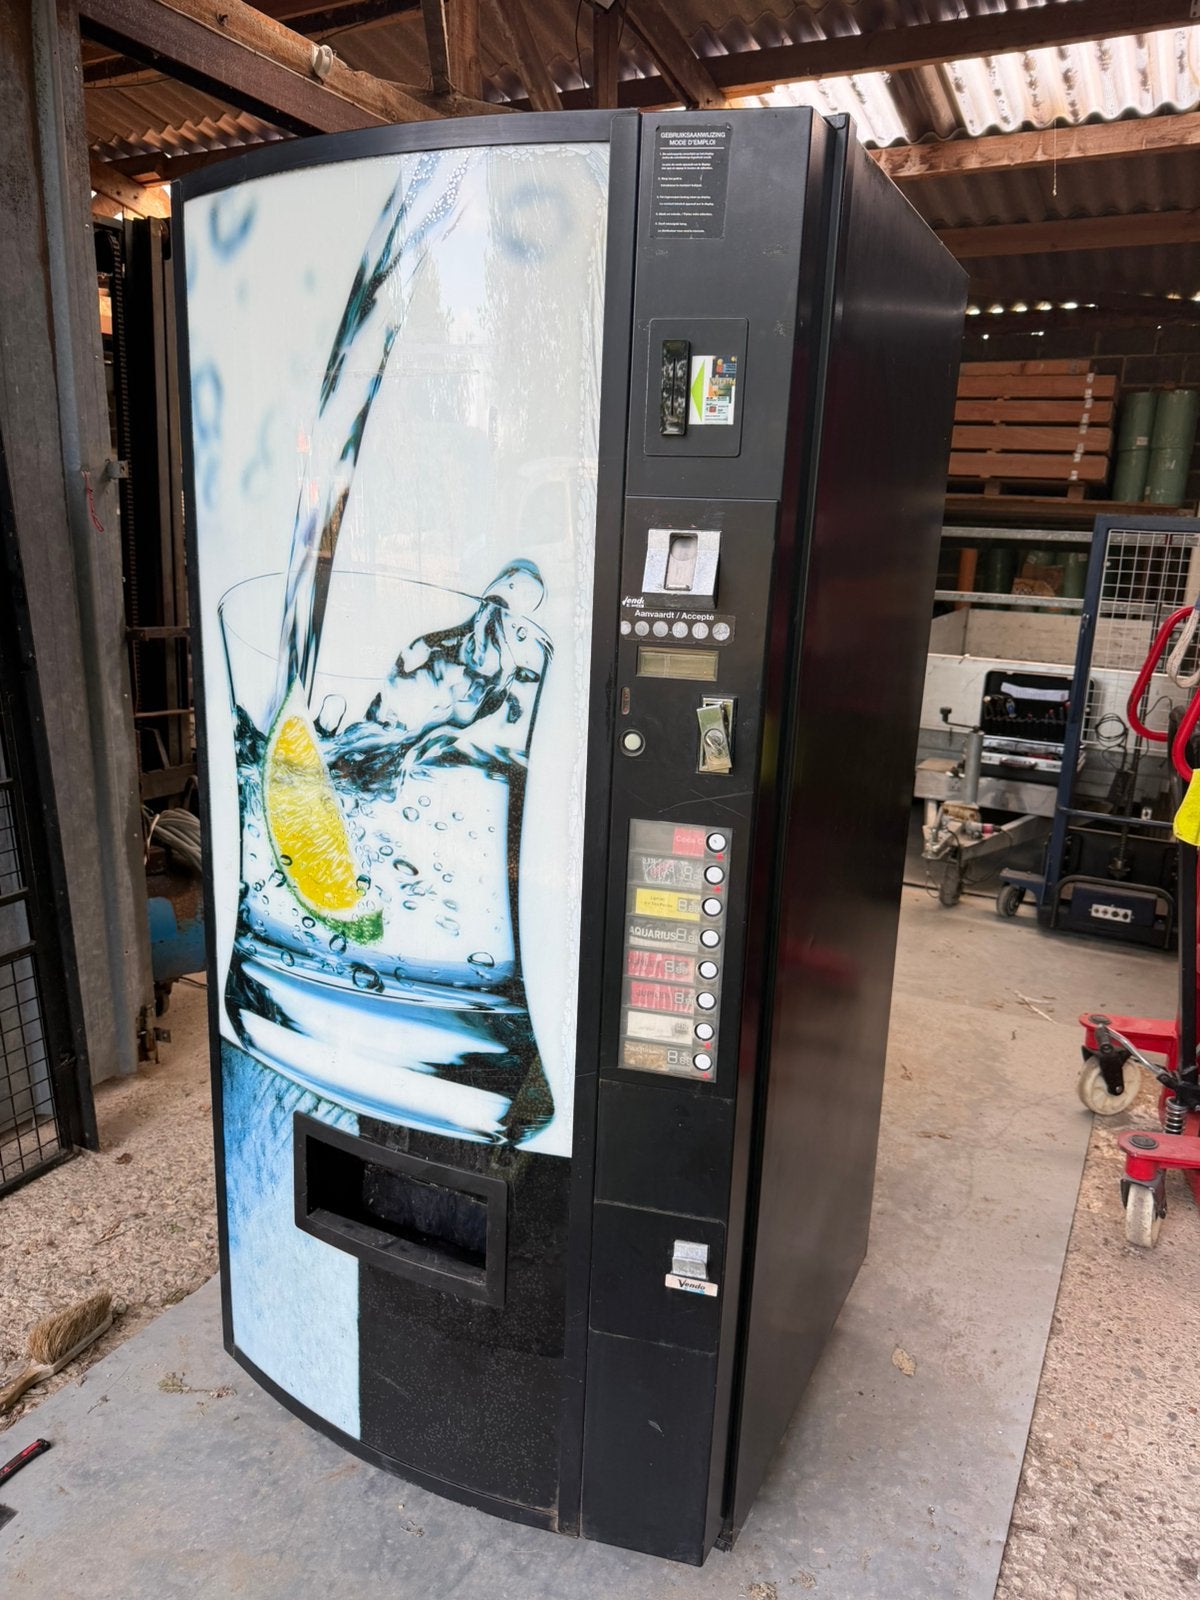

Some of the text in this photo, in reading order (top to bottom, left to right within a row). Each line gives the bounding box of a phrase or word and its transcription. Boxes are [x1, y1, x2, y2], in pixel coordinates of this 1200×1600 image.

[660, 131, 726, 139] GEBRUIKSAANWIJZING
[634, 609, 675, 619] Aanvaardt
[629, 925, 677, 941] AQUARIUS
[678, 1278, 706, 1290] Vendo
